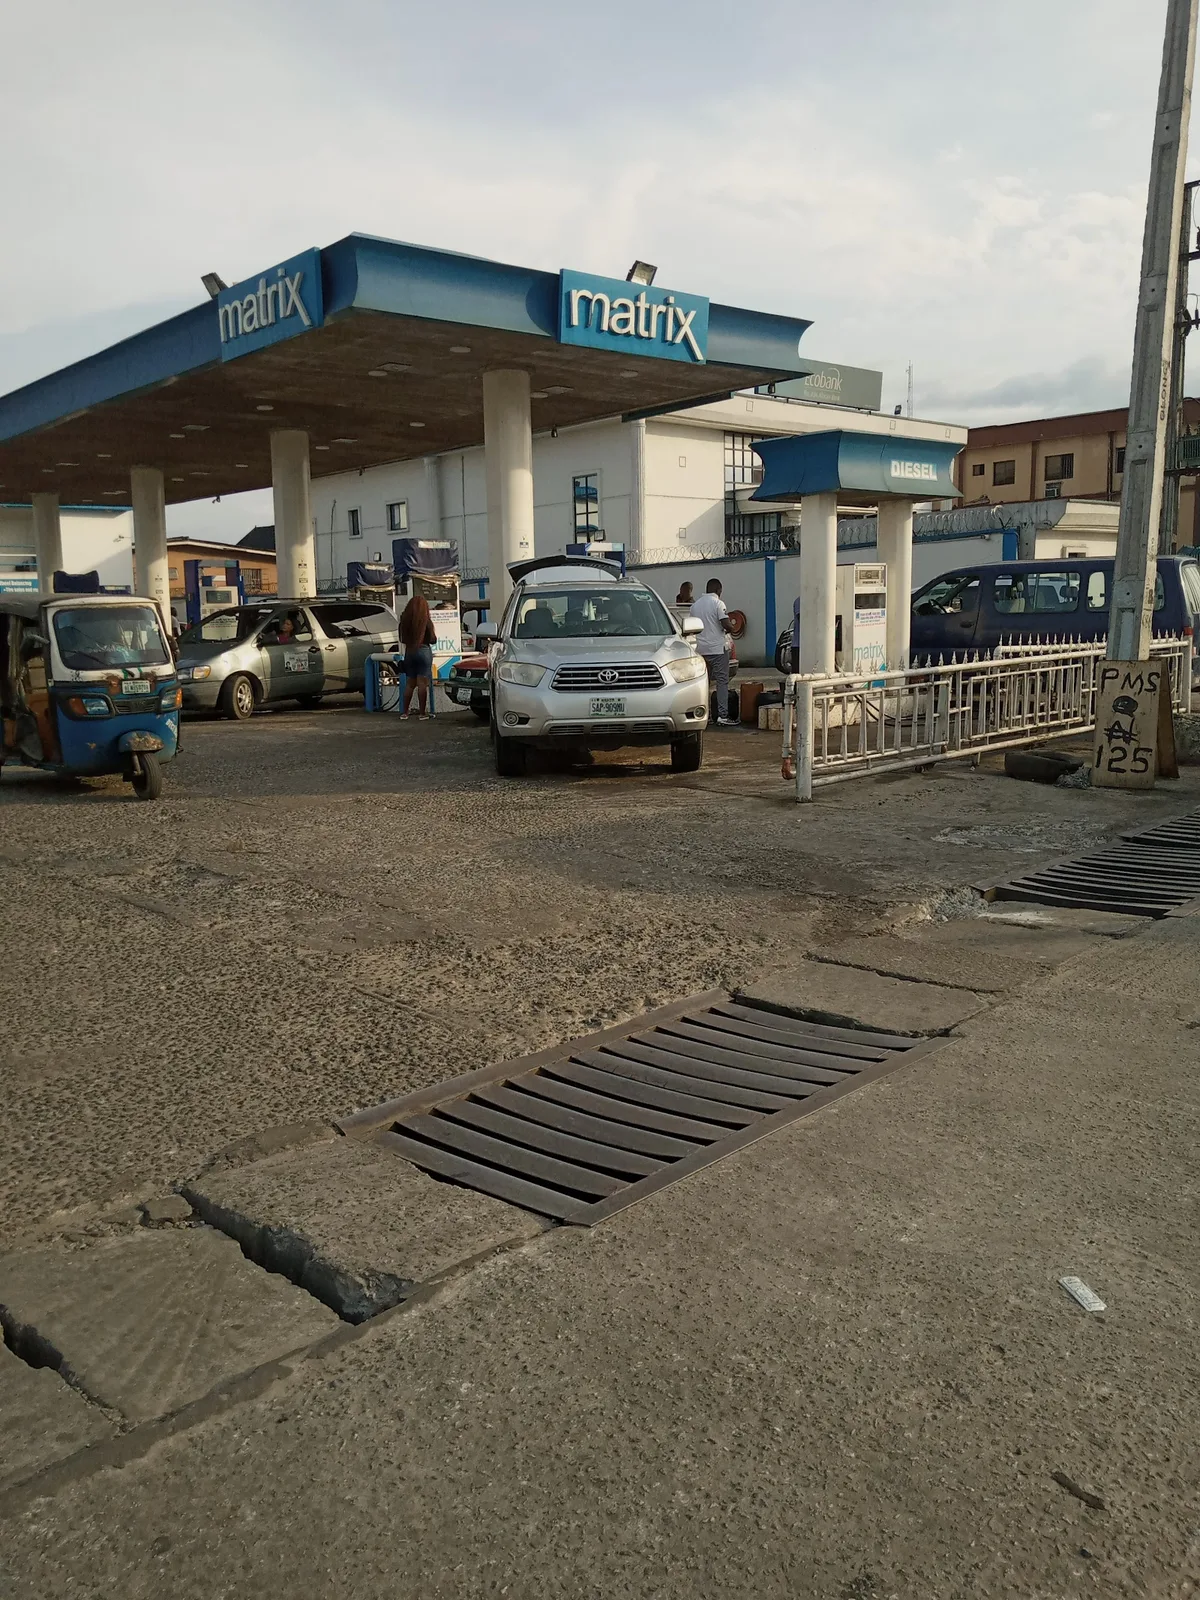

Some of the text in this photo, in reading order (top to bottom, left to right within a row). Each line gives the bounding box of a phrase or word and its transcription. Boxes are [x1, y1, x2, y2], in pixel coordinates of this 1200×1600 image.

[219, 268, 312, 343] matrix
[570, 289, 704, 361] matrix
[804, 370, 843, 391] Ecobank
[891, 461, 938, 481] DIESEL
[431, 636, 458, 652] atrix
[854, 641, 886, 662] matrix
[1100, 668, 1160, 695] PMS
[1095, 744, 1153, 774] 125
